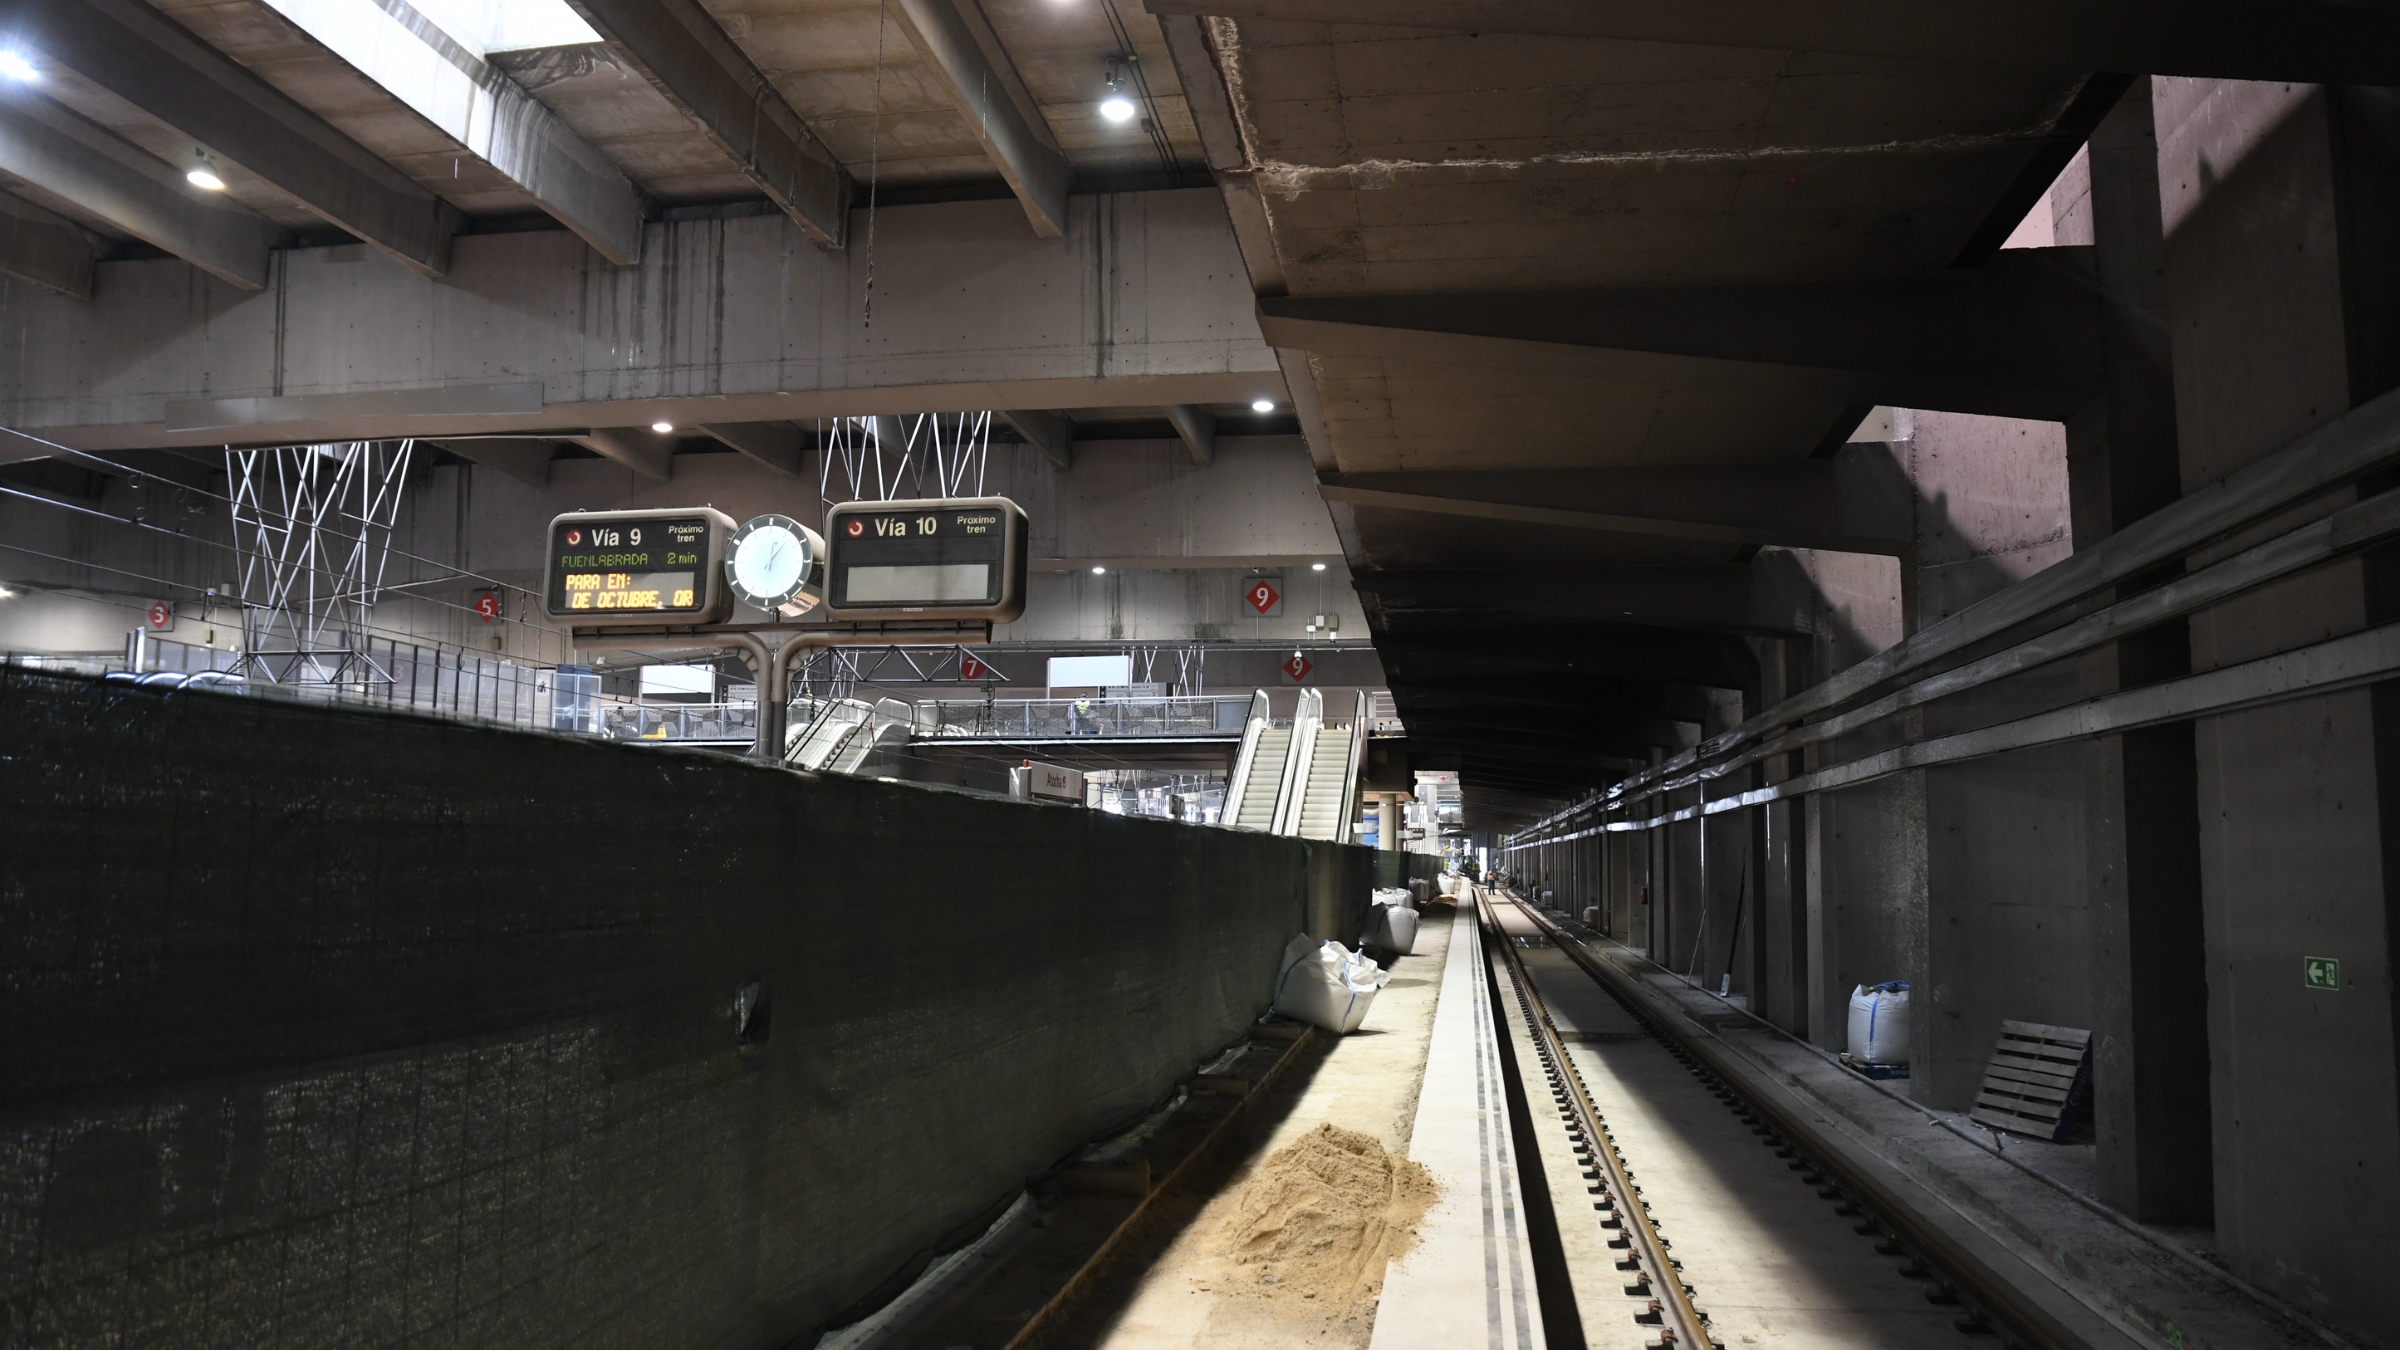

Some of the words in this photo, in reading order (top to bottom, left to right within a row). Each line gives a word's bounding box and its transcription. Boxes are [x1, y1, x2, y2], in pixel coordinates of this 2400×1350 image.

[874, 518, 906, 537] Vía
[916, 516, 937, 535] 10
[957, 515, 996, 525] Proximo
[591, 528, 620, 547] Vía
[630, 528, 641, 545] 9
[668, 525, 704, 534] Próximo
[966, 525, 986, 534] tren
[677, 534, 695, 543] tren
[561, 553, 648, 567] FUENLABRADA
[667, 552, 676, 564] 2
[679, 552, 697, 564] min
[565, 574, 600, 591] PARA
[607, 573, 631, 589] EN:
[571, 592, 590, 609] DE
[597, 590, 663, 608] OCTUBRE,
[673, 590, 694, 607] OR
[1256, 587, 1269, 607] 9
[154, 606, 164, 623] 3
[482, 599, 492, 616] 5
[967, 660, 978, 677] 7
[1292, 659, 1303, 676] 9
[1047, 772, 1062, 789] Atocha
